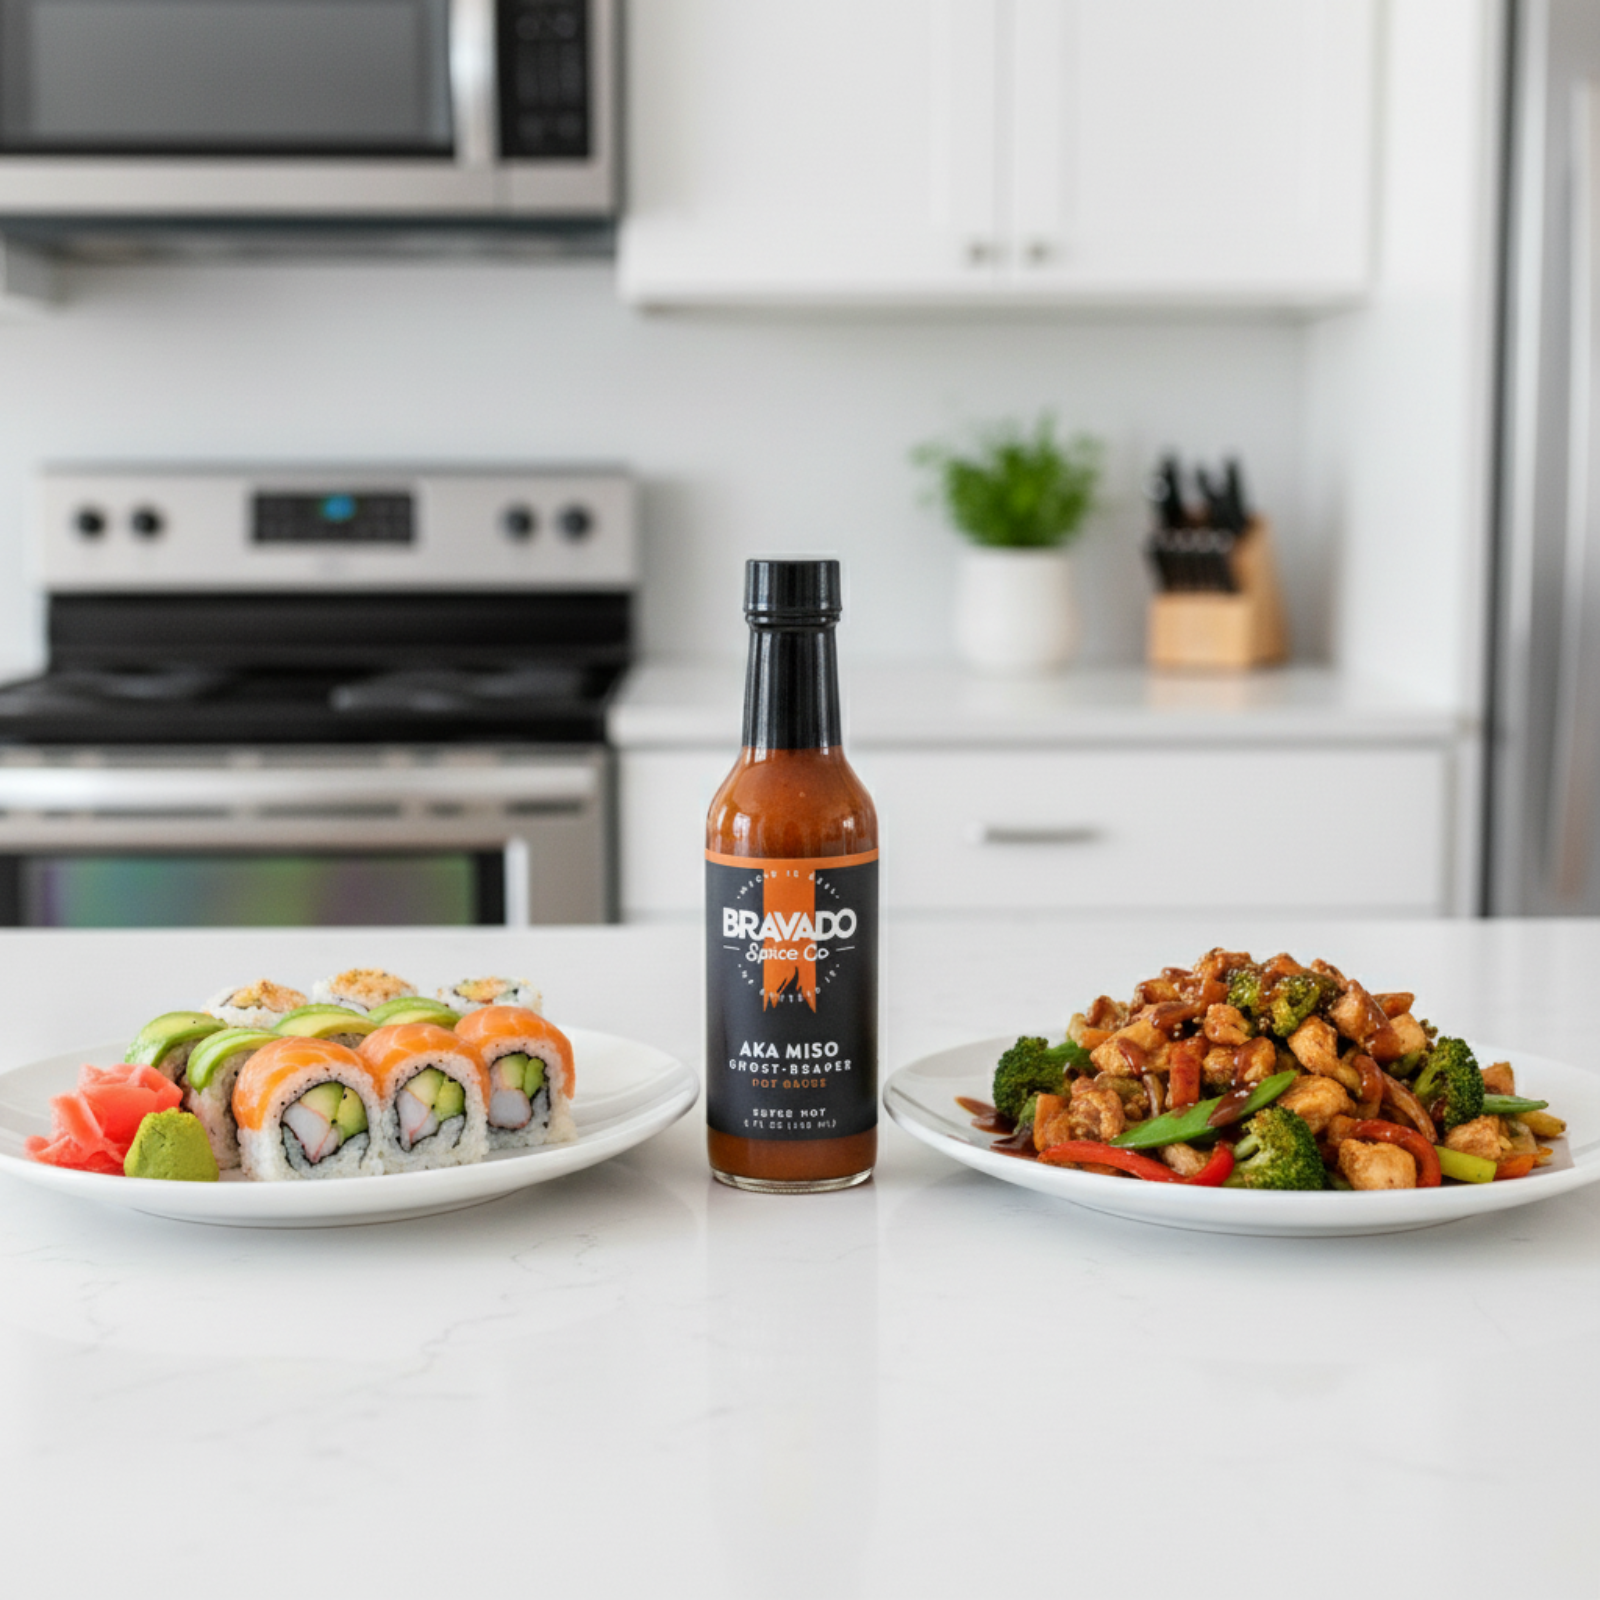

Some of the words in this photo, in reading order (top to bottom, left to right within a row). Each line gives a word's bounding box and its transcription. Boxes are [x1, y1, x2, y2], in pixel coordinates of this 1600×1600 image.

[723, 907, 857, 942] BRAVADO
[745, 942, 798, 964] Spice
[803, 943, 829, 961] Co
[739, 1040, 780, 1059] AKA
[785, 1041, 839, 1059] MISO
